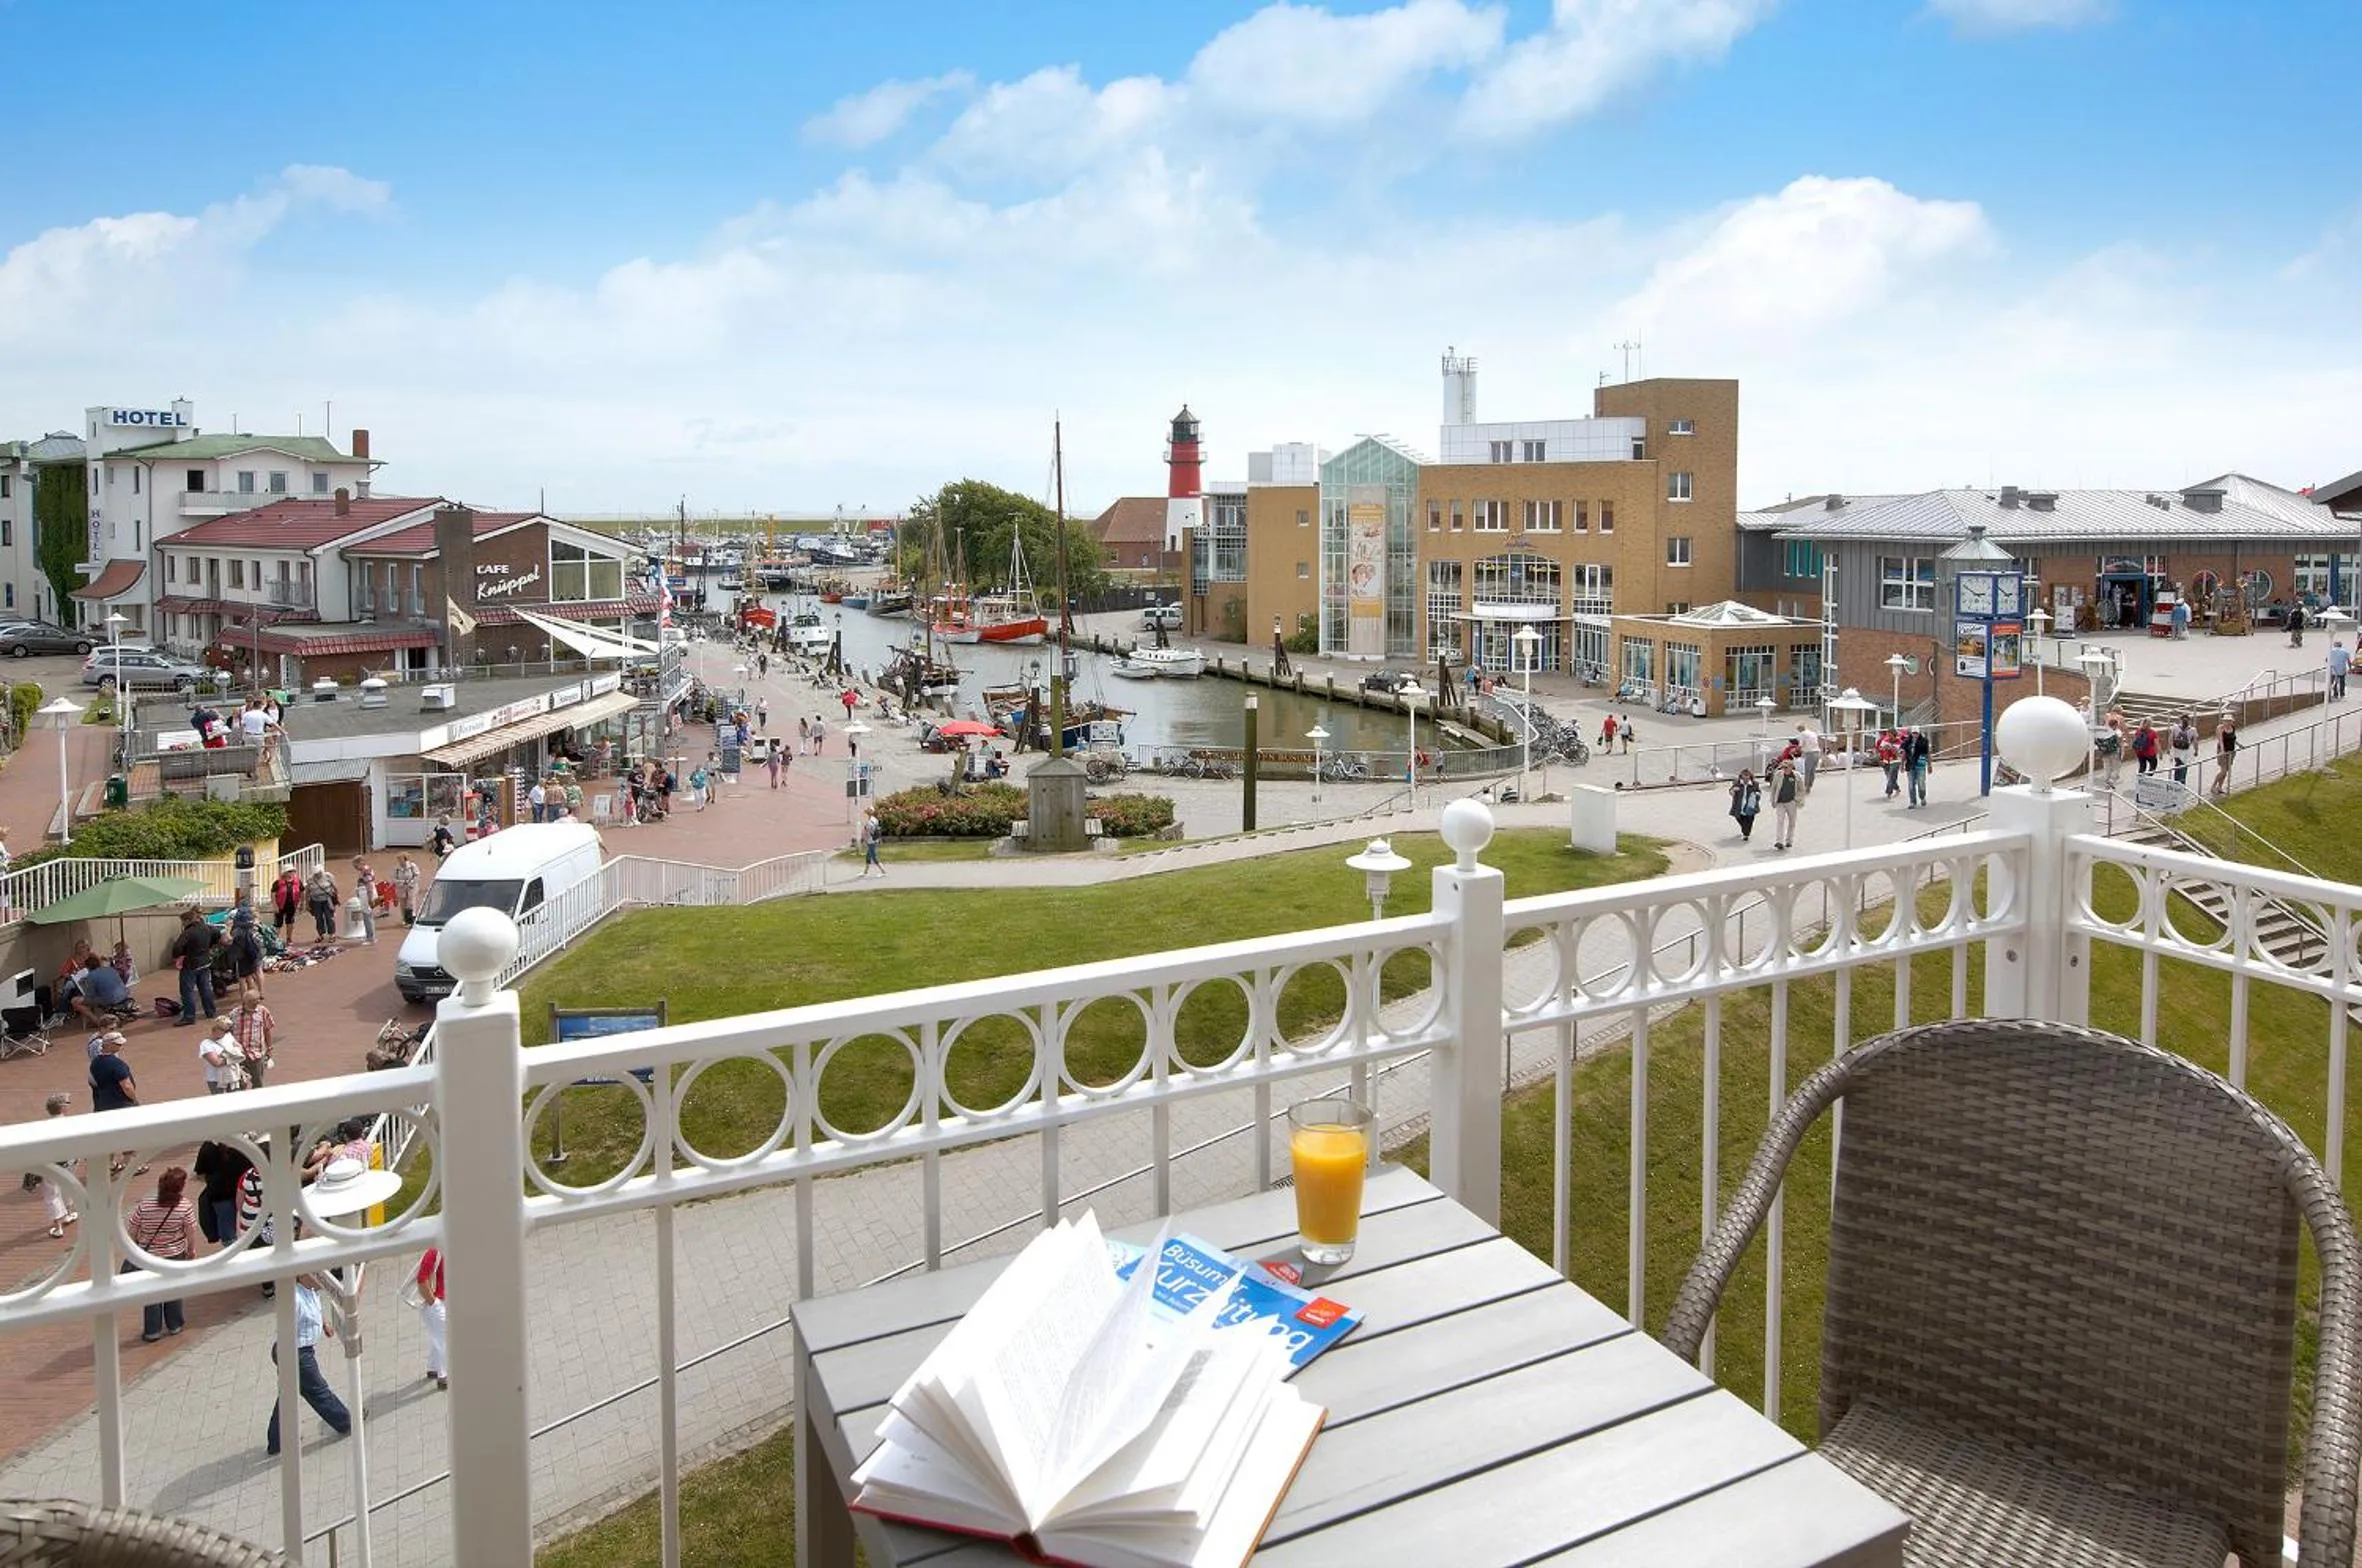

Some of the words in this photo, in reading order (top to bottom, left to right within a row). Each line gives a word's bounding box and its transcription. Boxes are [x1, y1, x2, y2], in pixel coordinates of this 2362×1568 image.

[113, 410, 187, 426] HOTEL
[91, 509, 100, 561] HOTEL
[476, 564, 510, 574] CAFE
[477, 564, 540, 600] Knüppel
